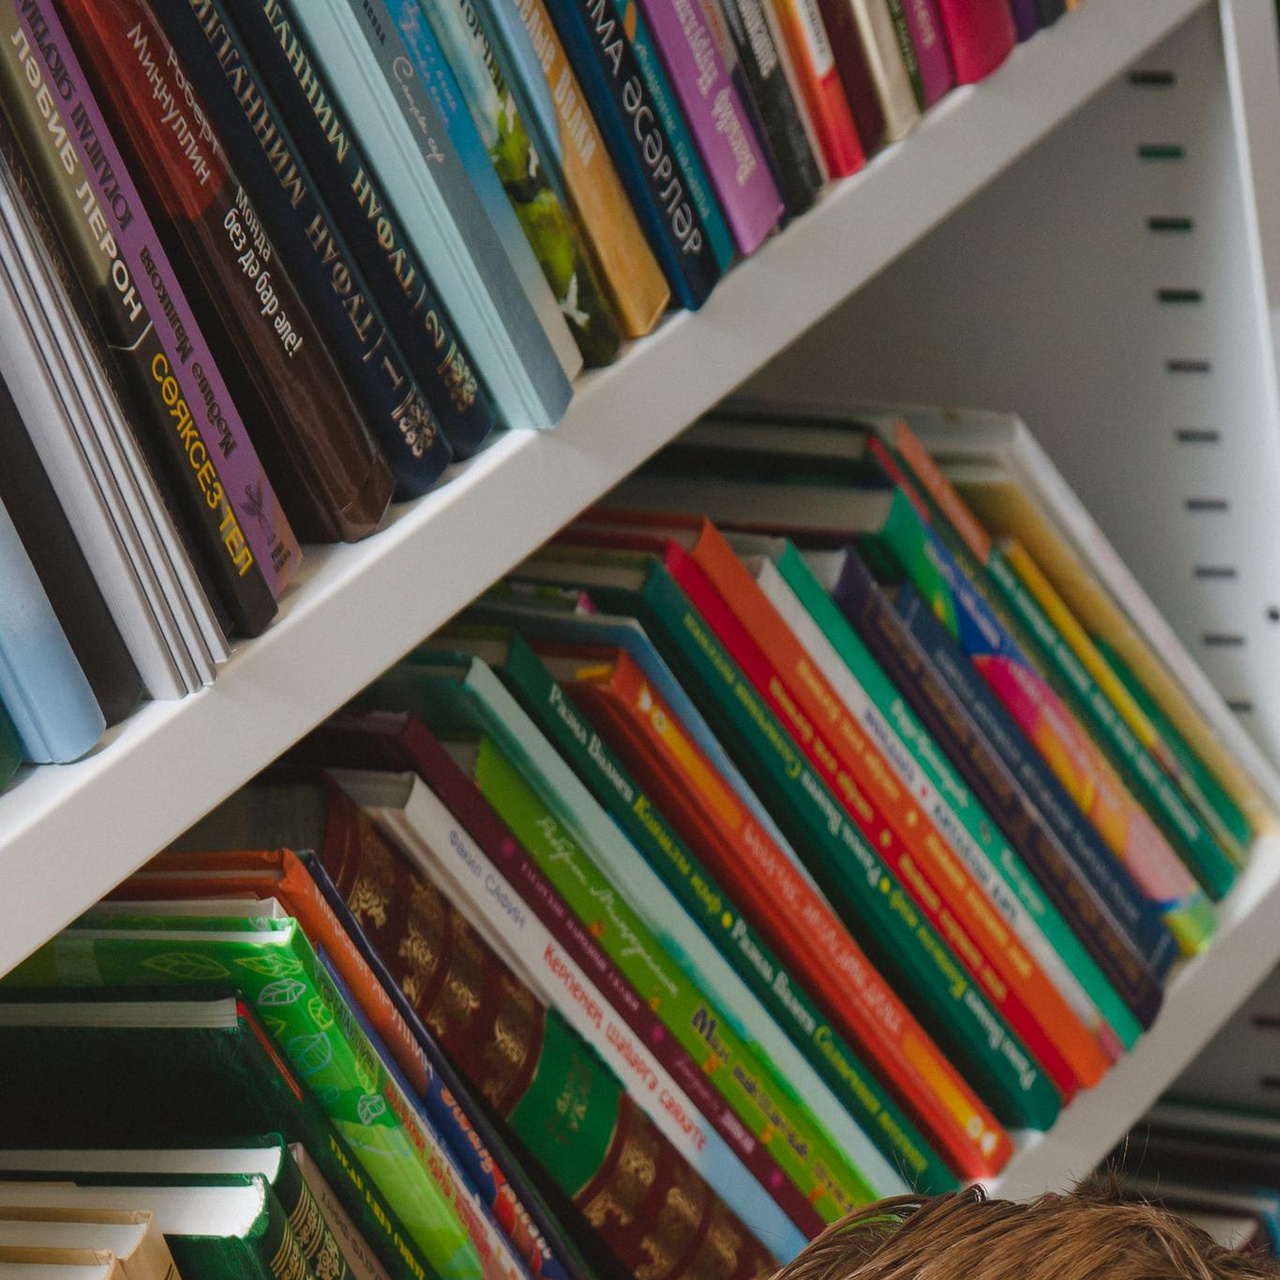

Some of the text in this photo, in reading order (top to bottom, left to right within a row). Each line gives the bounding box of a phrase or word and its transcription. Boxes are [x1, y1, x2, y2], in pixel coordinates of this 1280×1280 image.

[127, 25, 211, 186] Миңнуллин
[166, 48, 221, 153] Роберт
[10, 29, 79, 175] ЛӘБИБ
[76, 184, 142, 322] ЛЕРОН
[234, 188, 271, 263] Монда
[354, 171, 415, 294] ТУФАН
[623, 85, 700, 255] ӘСӘРЛӘР
[140, 246, 189, 363] Маликова
[221, 207, 303, 356] без дә бар әле!
[306, 215, 370, 341] ТУФАН
[425, 312, 449, 349] 2
[152, 355, 252, 578] СӨЯКСЕЗ ТЕЛ
